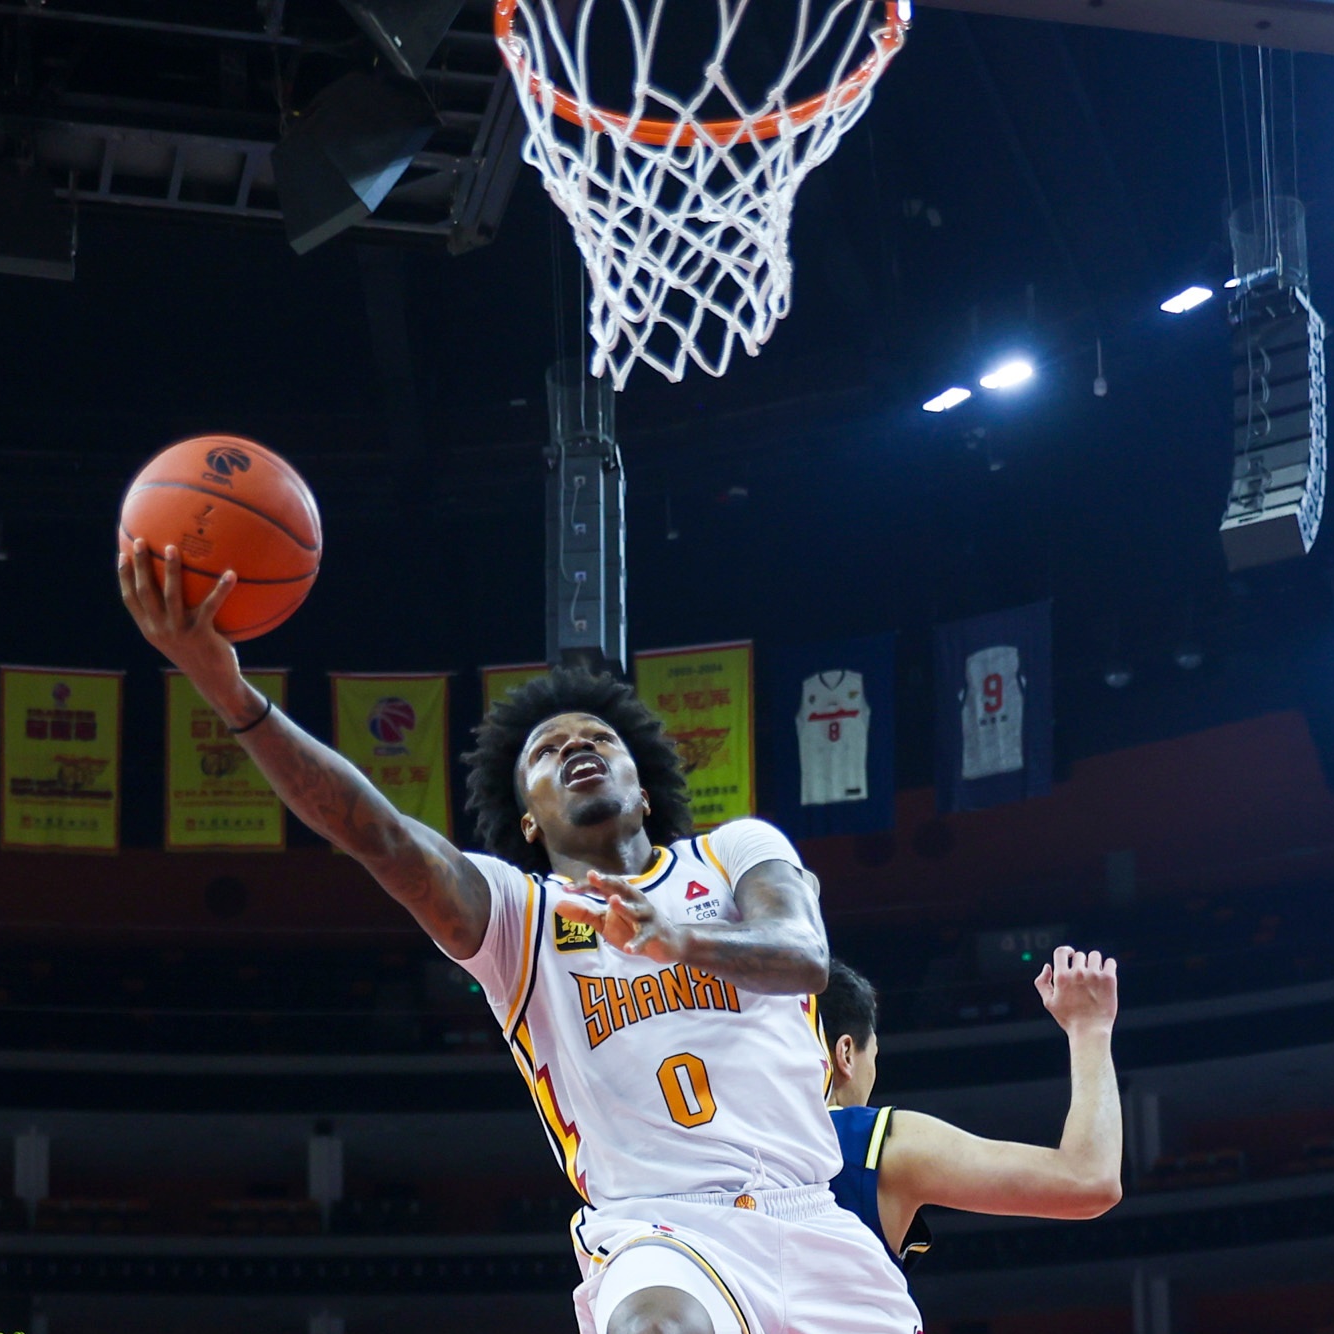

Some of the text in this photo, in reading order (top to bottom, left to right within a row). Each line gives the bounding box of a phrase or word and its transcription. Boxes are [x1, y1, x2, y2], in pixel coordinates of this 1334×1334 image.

[982, 672, 1004, 713] 9
[827, 721, 842, 743] 8
[686, 899, 720, 916] 广发银行
[696, 909, 718, 921] CGB
[657, 1052, 717, 1129] 0
